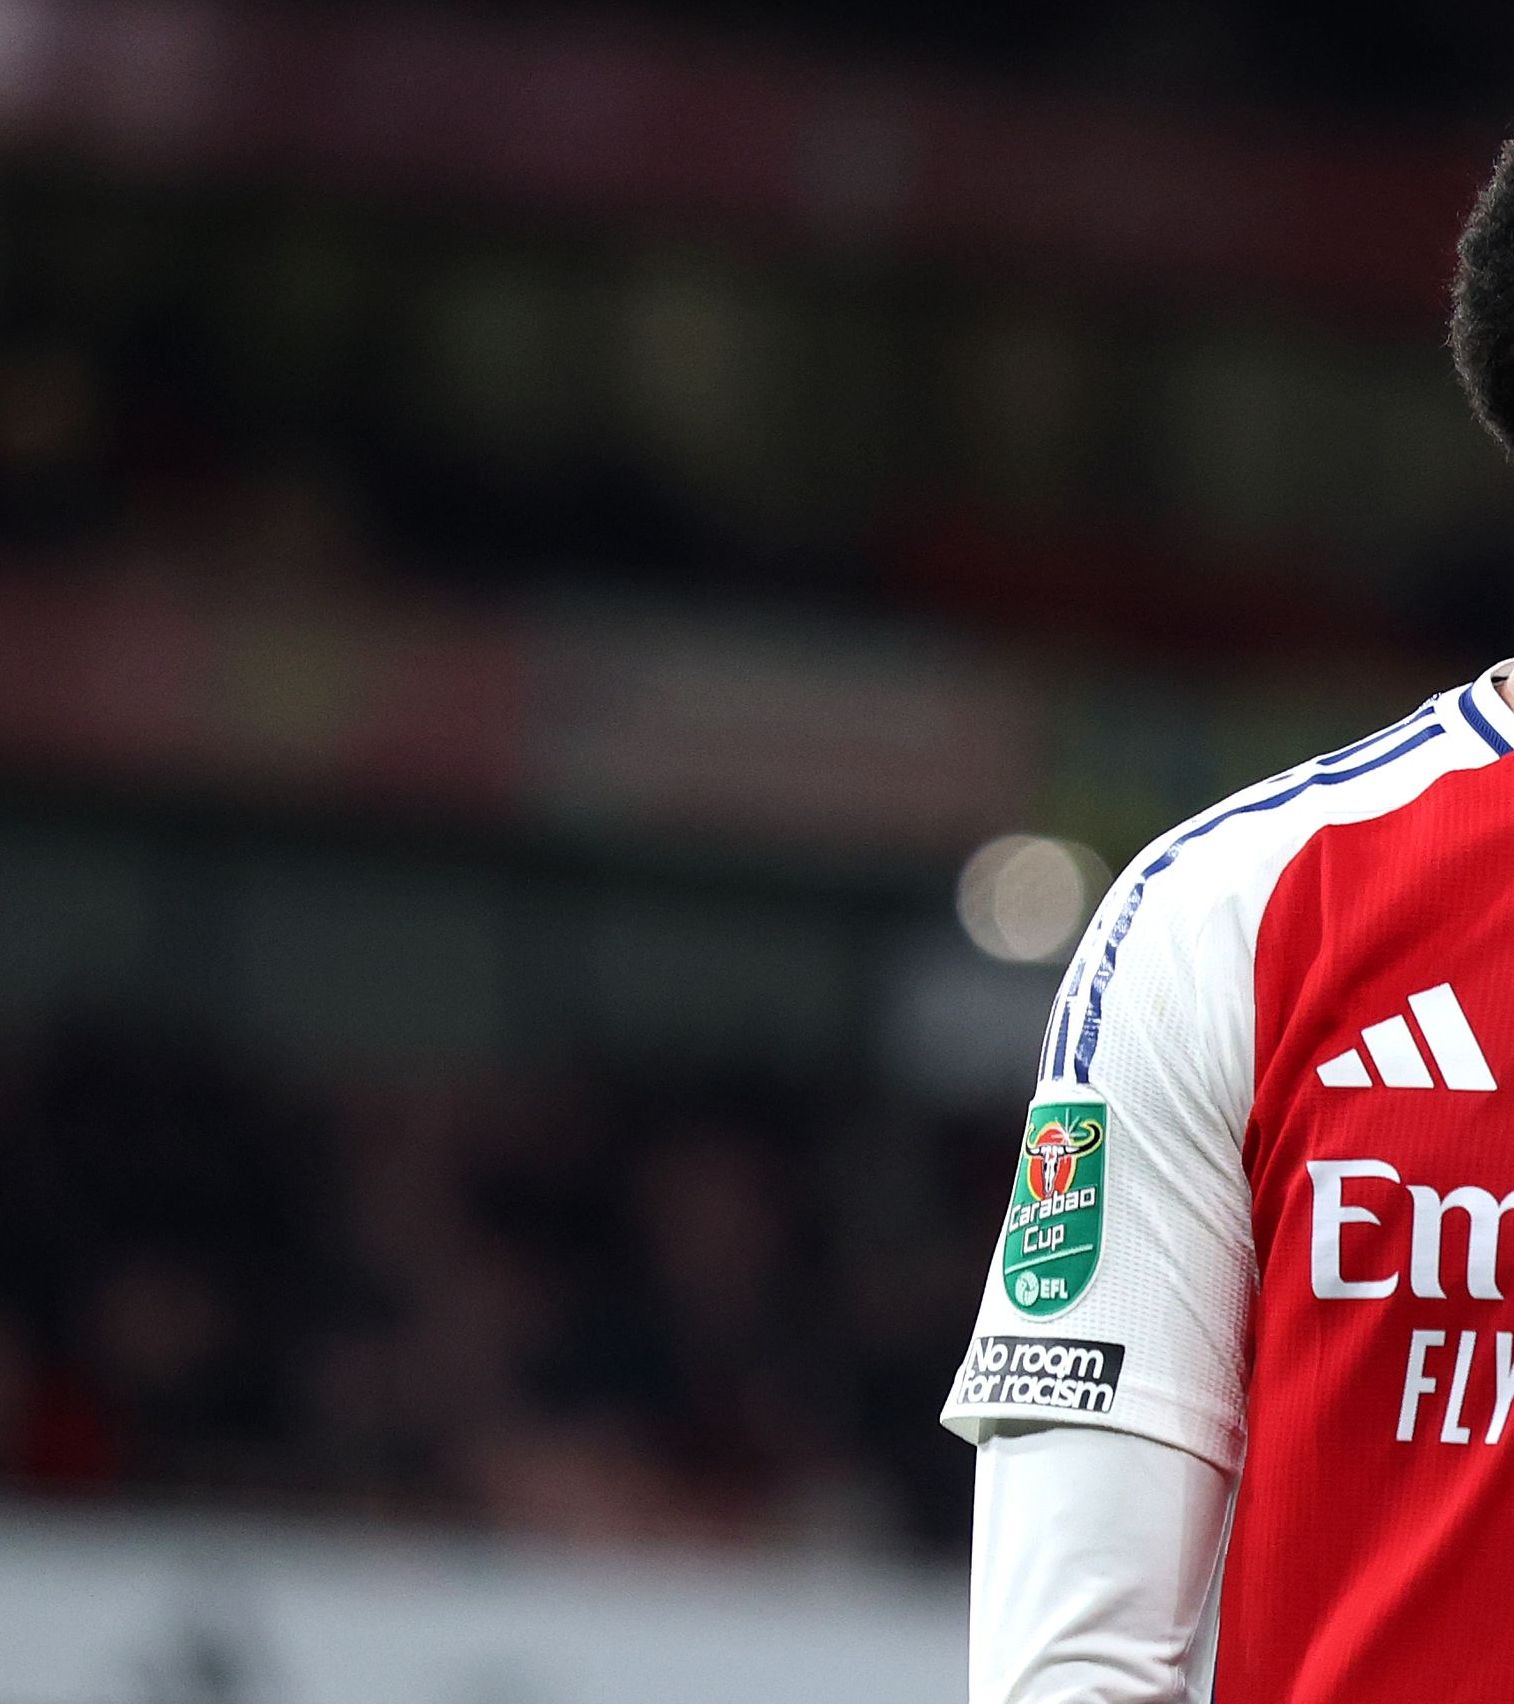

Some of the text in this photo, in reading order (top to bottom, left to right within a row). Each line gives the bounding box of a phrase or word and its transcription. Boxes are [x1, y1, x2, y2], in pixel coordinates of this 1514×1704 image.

[1009, 1187, 1096, 1233] Carabao
[1023, 1223, 1065, 1253] Cup
[1040, 1278, 1068, 1299] EFL
[968, 1337, 1104, 1379] No room
[960, 1369, 1113, 1412] for racism
